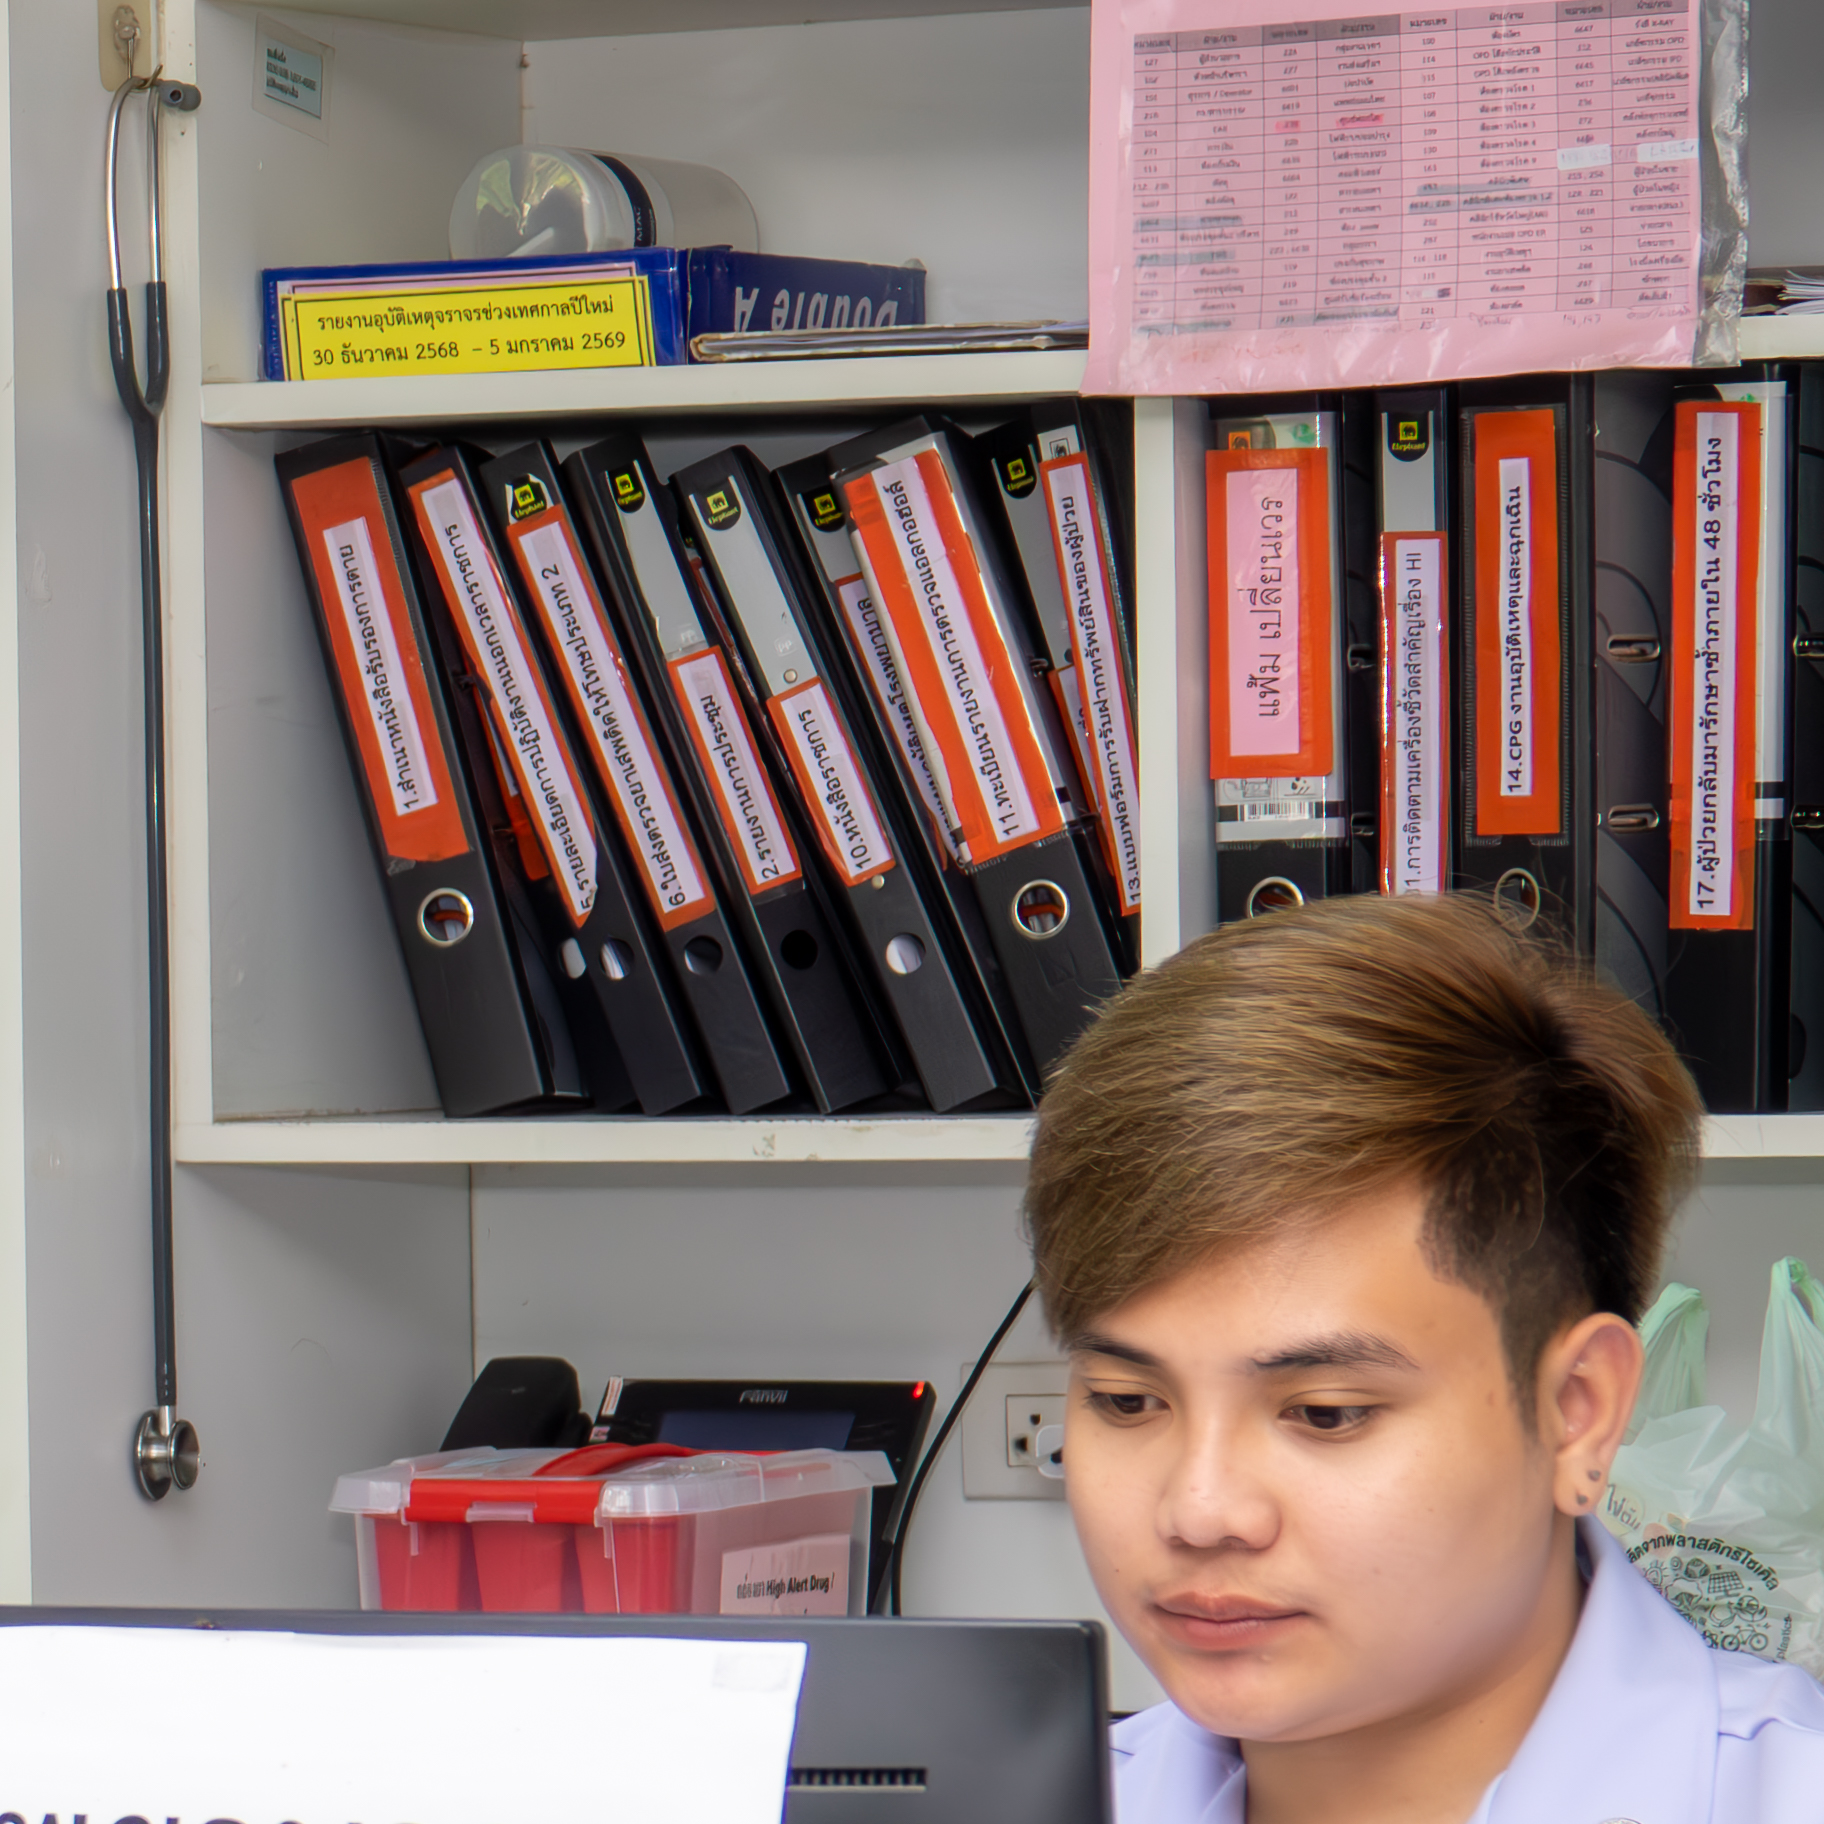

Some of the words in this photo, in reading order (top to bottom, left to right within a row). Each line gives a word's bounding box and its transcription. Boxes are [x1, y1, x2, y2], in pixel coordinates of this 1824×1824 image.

[312, 344, 335, 368] 30
[340, 339, 410, 367] ธันวาคม
[414, 339, 460, 362] 2568
[489, 337, 500, 356] 5
[505, 332, 575, 355] มกราคม
[580, 330, 626, 352] 2569
[316, 294, 615, 335] รายงานอุบัติเหตุจราจรช่วงเทศกาลปีใหม่
[514, 500, 545, 519] Elephant
[1696, 436, 1722, 512] ชั่วโมง
[707, 506, 740, 525] Elephant
[1702, 518, 1721, 551] 48
[540, 563, 561, 582] 2
[1237, 496, 1283, 639] เปลี่ยนเวร
[1405, 551, 1422, 571] HI
[1504, 485, 1525, 714] งานอุบัติเหตุและฉุกเฉิน
[339, 541, 421, 811] 1.สำเนาหนังสือรับรองการตาย
[882, 478, 1017, 838] 11.ทะเบียนรายงานการตรวจแอลกอฮอล์
[1245, 653, 1281, 717] แฟ้ม
[549, 587, 690, 910] 6.ใบส่งตรวจยาเสพติดให้โทษประเภท
[1396, 578, 1426, 896] 1.การติดตามเครื่องชี้วัดสำคัญเรื่อง
[1506, 719, 1523, 793] 14.CPG
[1695, 557, 1720, 908] 17.ผู้ป่วยกลับมารักษาซ้ำภายใน
[701, 690, 799, 880] 2.รายงานการประชุม
[799, 707, 873, 870] 10.หนังสือราชการ
[765, 1577, 786, 1599] High
[787, 1575, 809, 1596] Alert
[810, 1574, 830, 1595] Drug
[1626, 1531, 1781, 1593] ลิตจากพลาสติกรีไซเคิล
